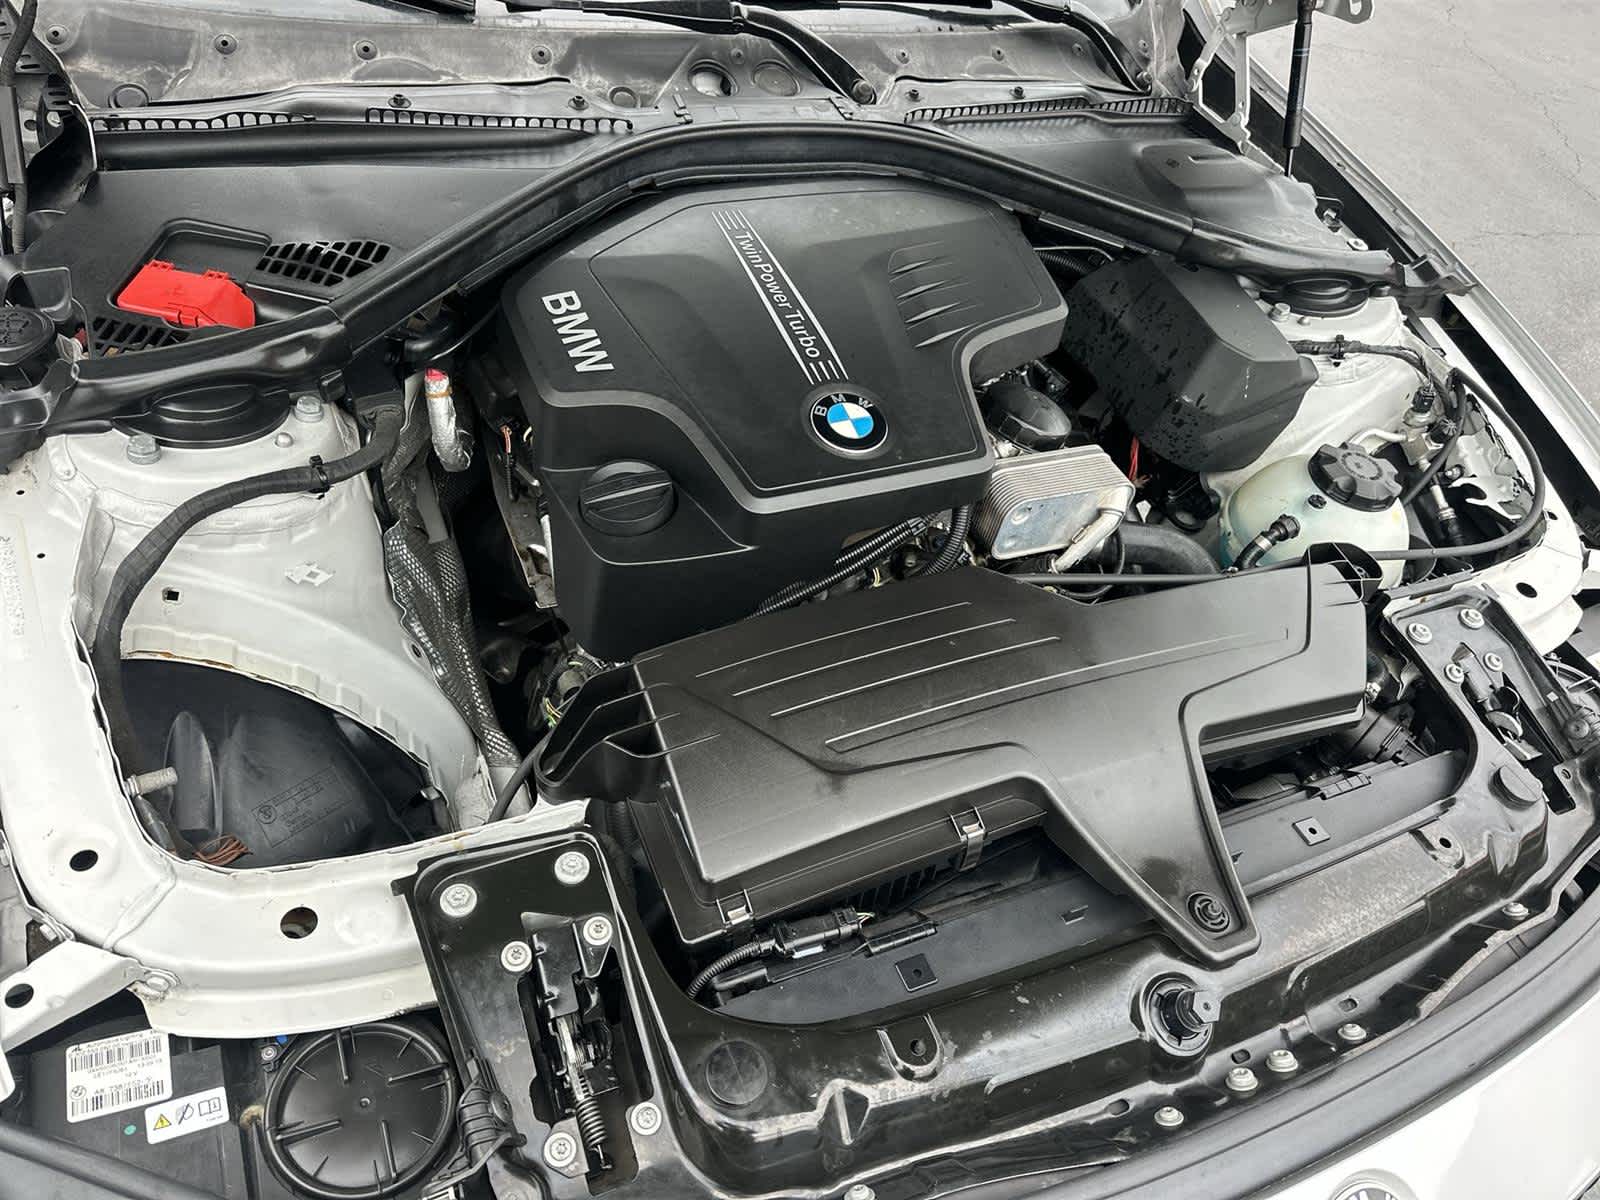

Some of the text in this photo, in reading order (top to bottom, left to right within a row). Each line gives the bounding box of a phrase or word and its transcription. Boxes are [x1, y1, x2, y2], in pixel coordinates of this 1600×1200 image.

[541, 290, 615, 372] BMW
[735, 231, 820, 358] TwinPower Turbo
[814, 393, 874, 416] BMW
